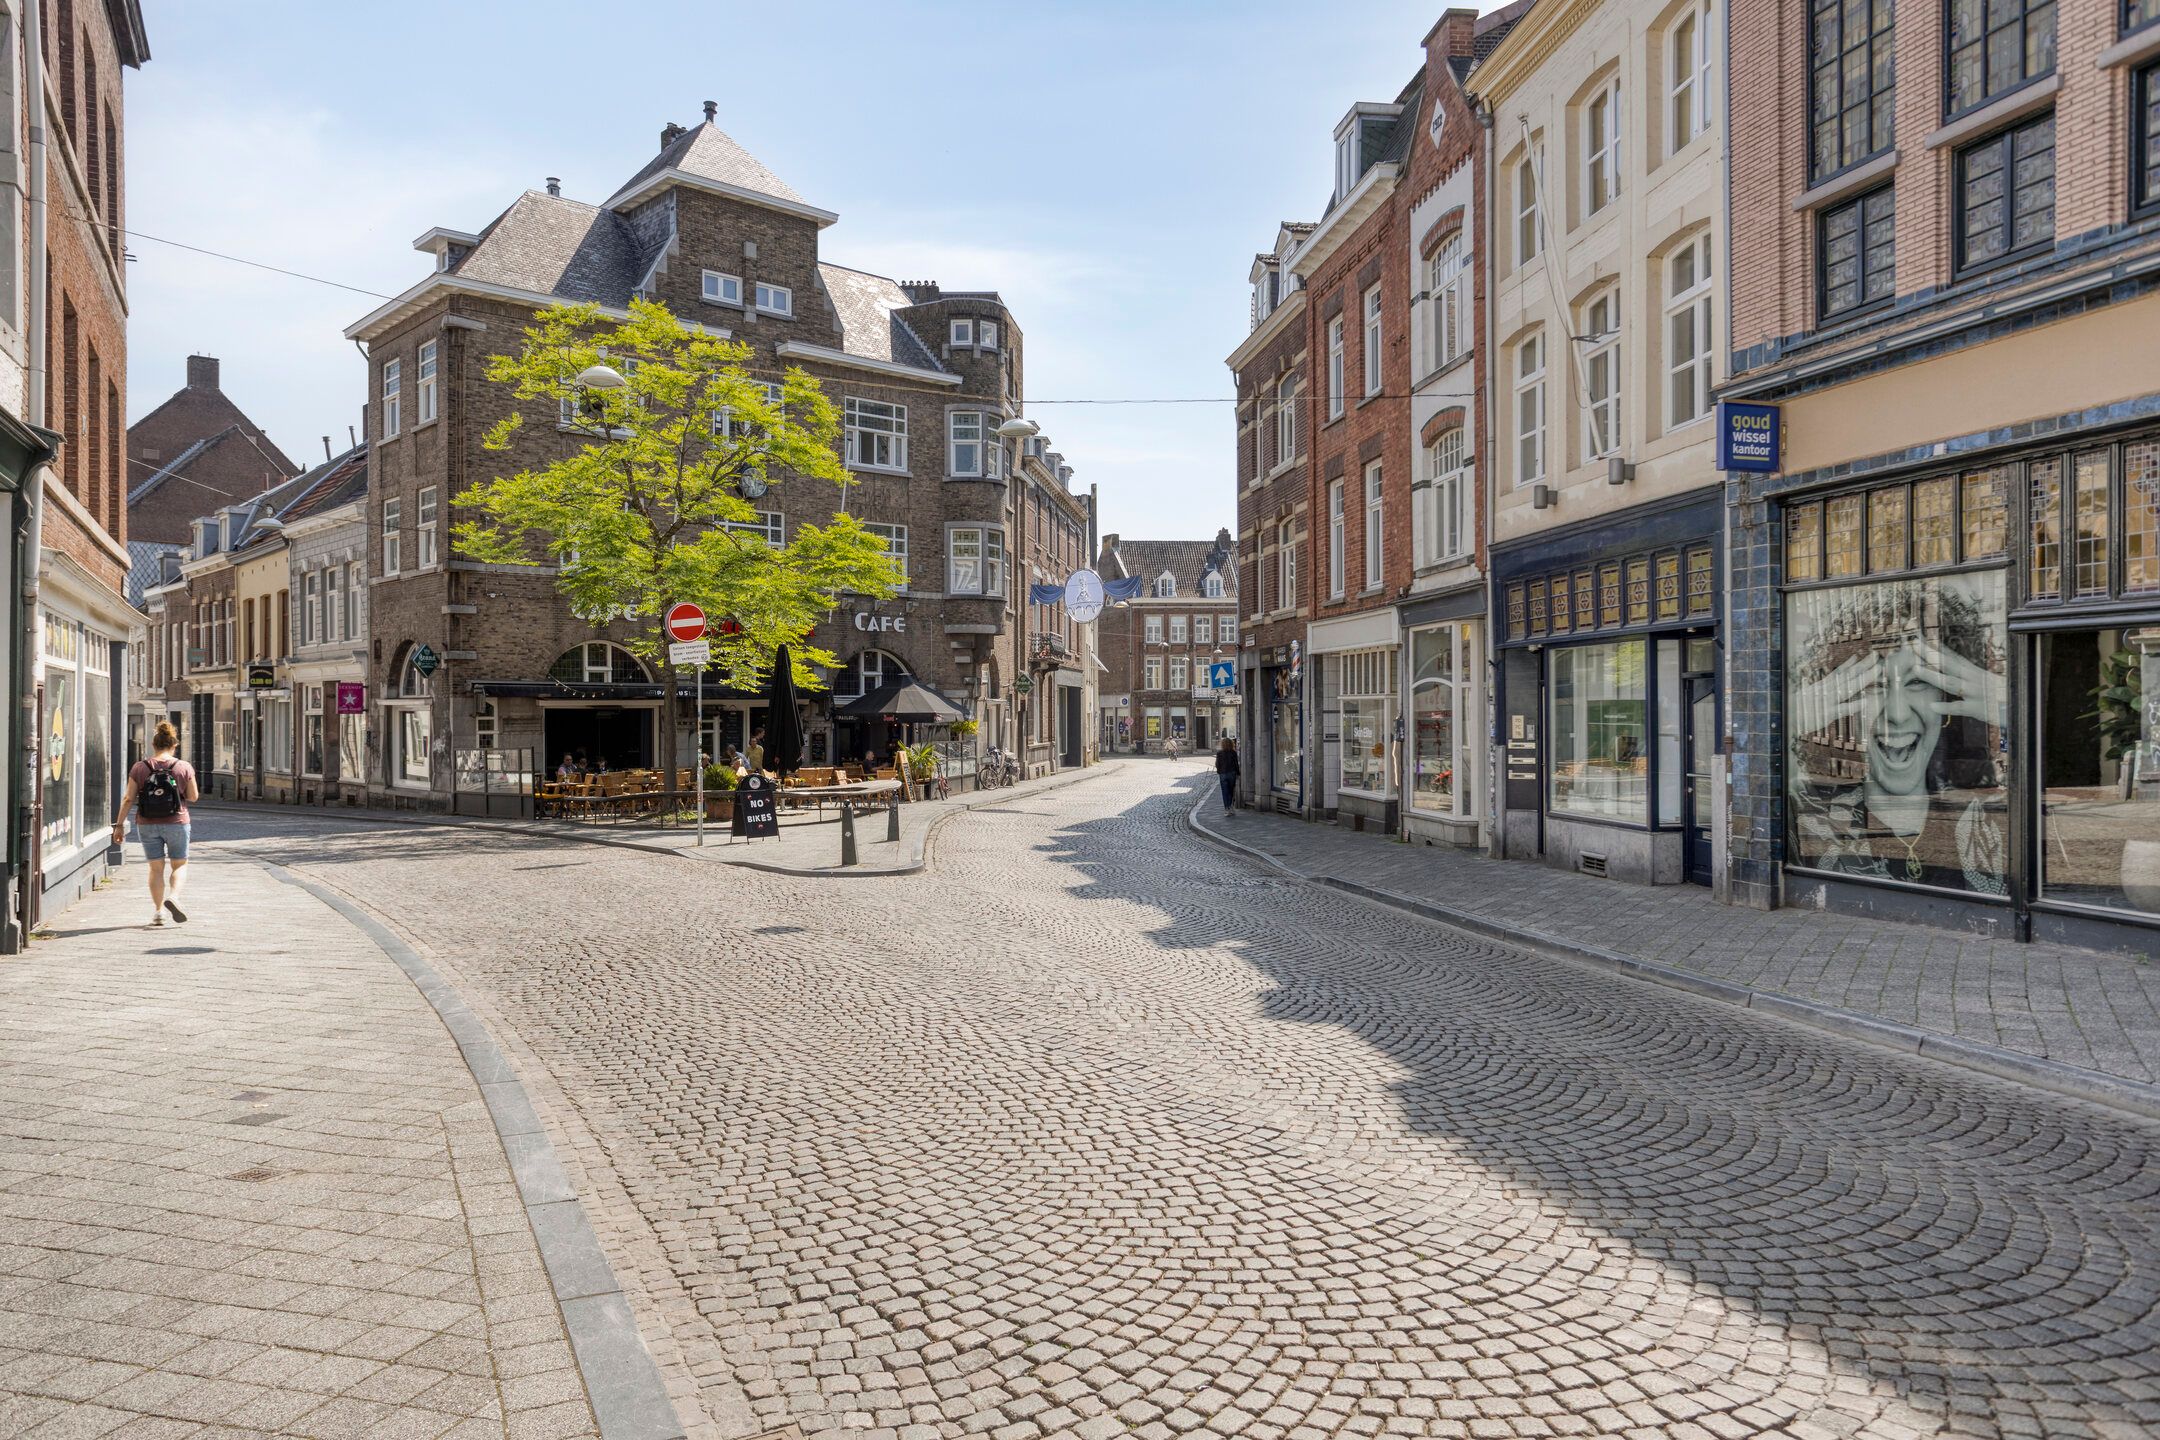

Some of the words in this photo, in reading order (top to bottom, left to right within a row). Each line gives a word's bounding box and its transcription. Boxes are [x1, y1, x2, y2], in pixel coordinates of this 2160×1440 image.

[1732, 414, 1771, 431] goud
[1732, 429, 1770, 444] wissel
[1732, 443, 1771, 456] kantoor
[750, 799, 764, 808] NO
[747, 813, 772, 823] BIKES
